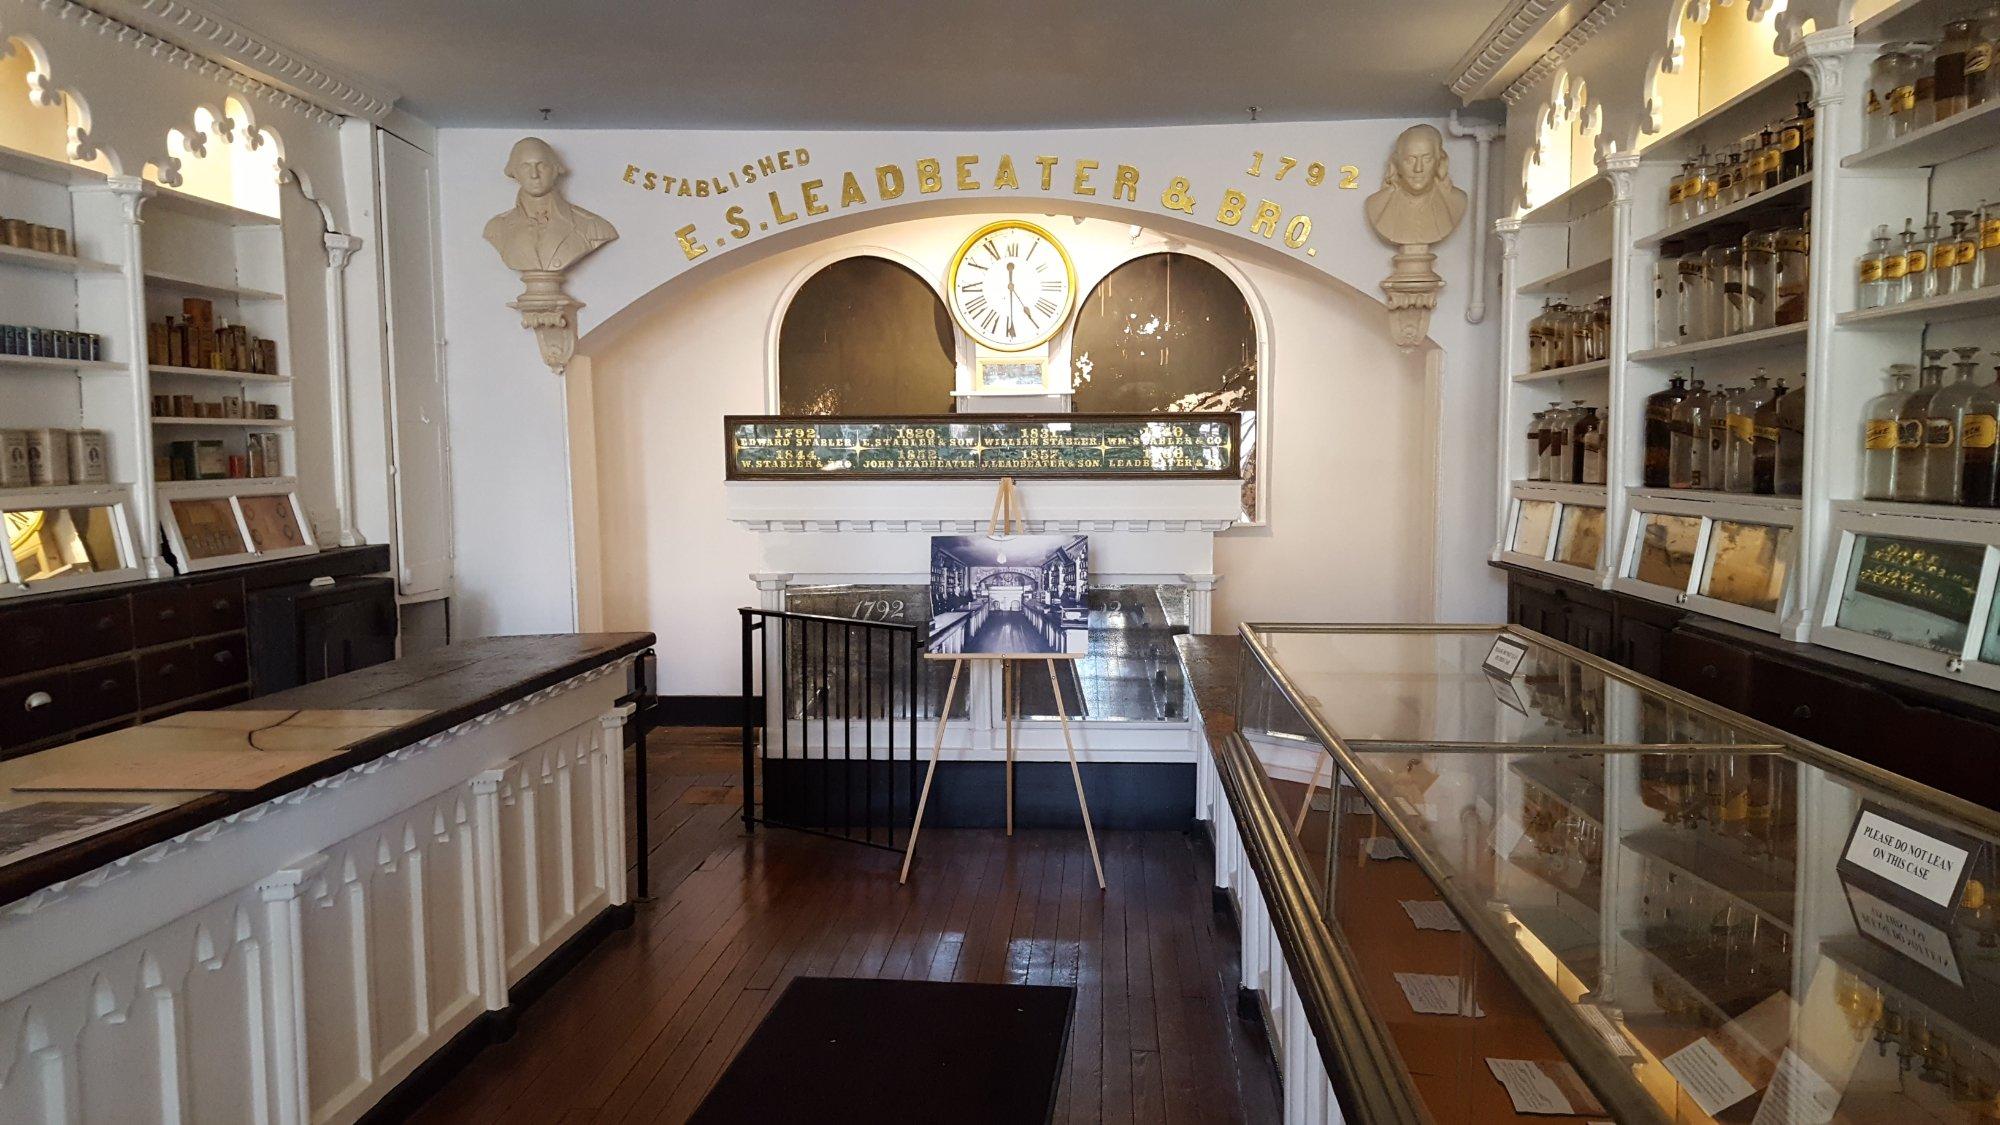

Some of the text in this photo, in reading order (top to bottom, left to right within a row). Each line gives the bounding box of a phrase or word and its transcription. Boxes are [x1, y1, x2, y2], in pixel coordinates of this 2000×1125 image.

[623, 148, 810, 197] ESTABLISHED
[1247, 151, 1359, 189] 1792
[1161, 176, 1196, 215] &
[1217, 188, 1316, 257] BRO.
[740, 438, 790, 447] EDWARD
[984, 437, 1039, 446] WILLIAM
[1107, 437, 1193, 446] WM.SABLER
[863, 460, 894, 468] JOHN
[851, 600, 904, 621] 1792
[1863, 826, 1954, 872] PLEASE DO NOT LEAN
[1872, 847, 1930, 880] ON THIS CASE
